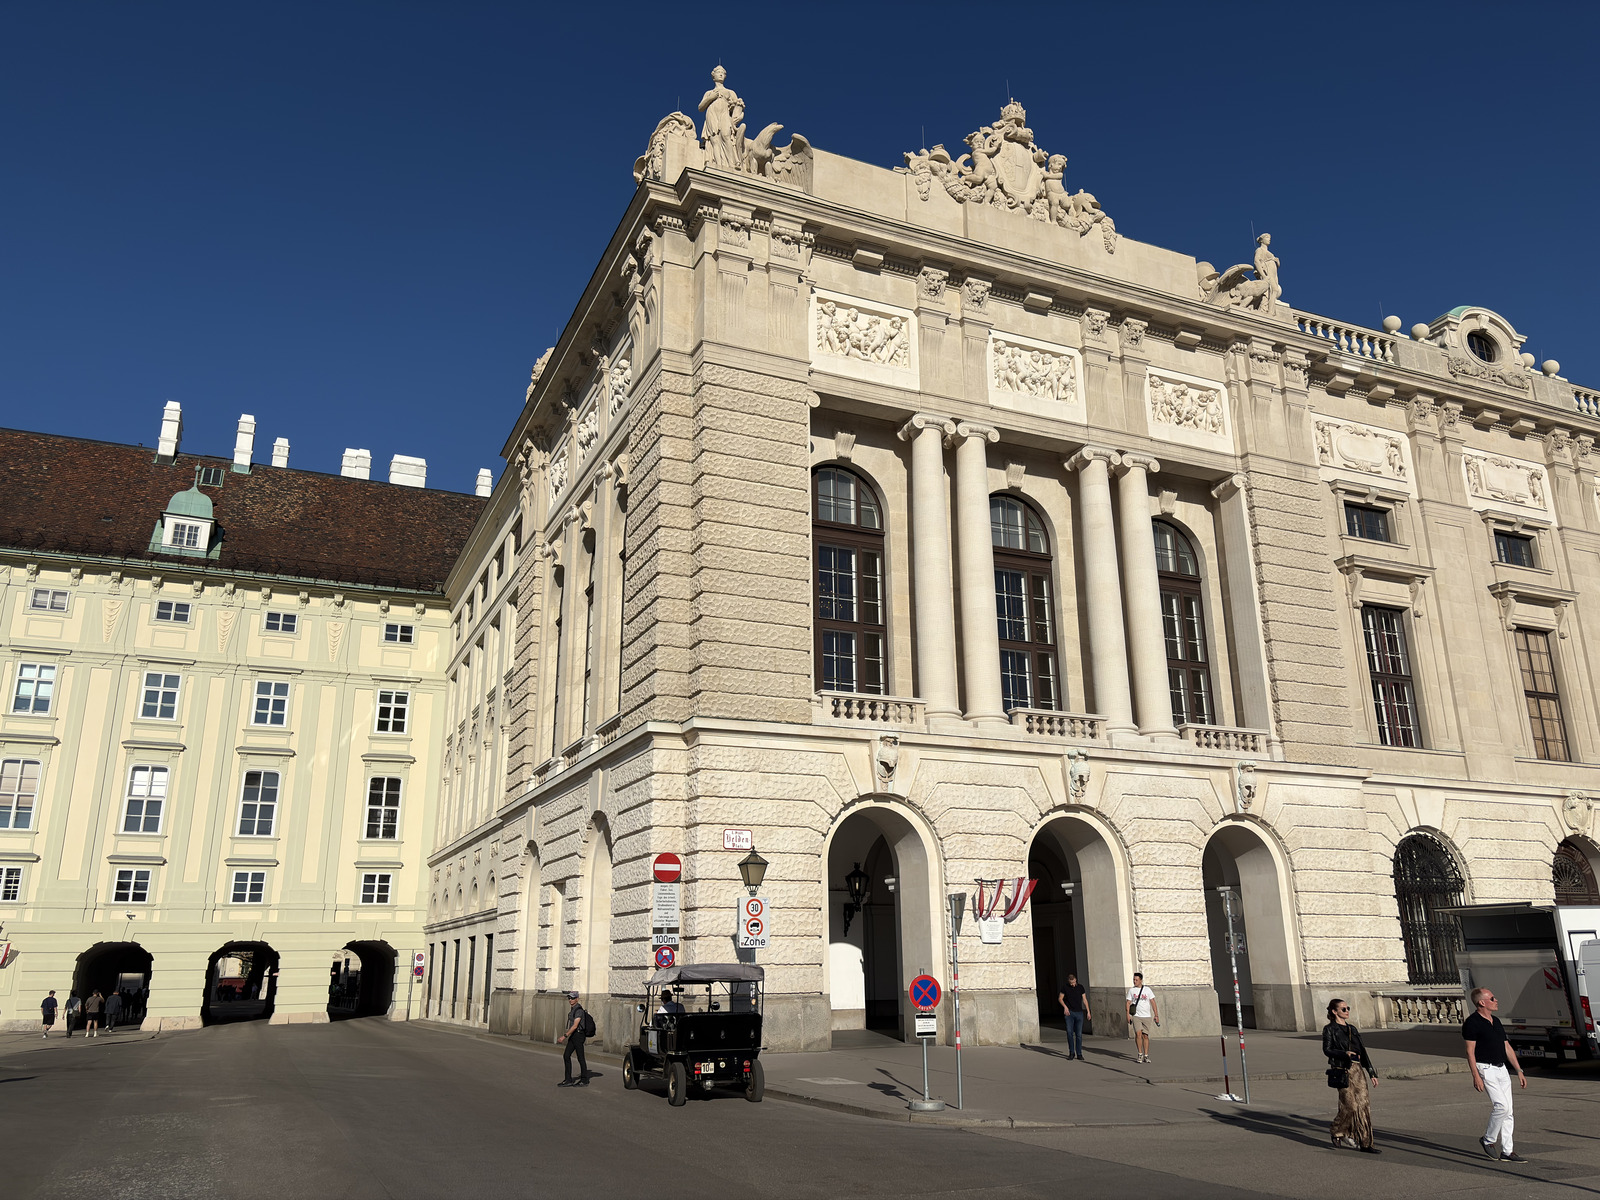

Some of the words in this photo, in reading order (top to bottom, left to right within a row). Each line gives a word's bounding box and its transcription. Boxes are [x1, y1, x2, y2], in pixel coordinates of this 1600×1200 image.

[750, 903, 759, 912] 30
[655, 935, 676, 944] 100m
[744, 936, 766, 946] Zone
[703, 1064, 710, 1072] 10
